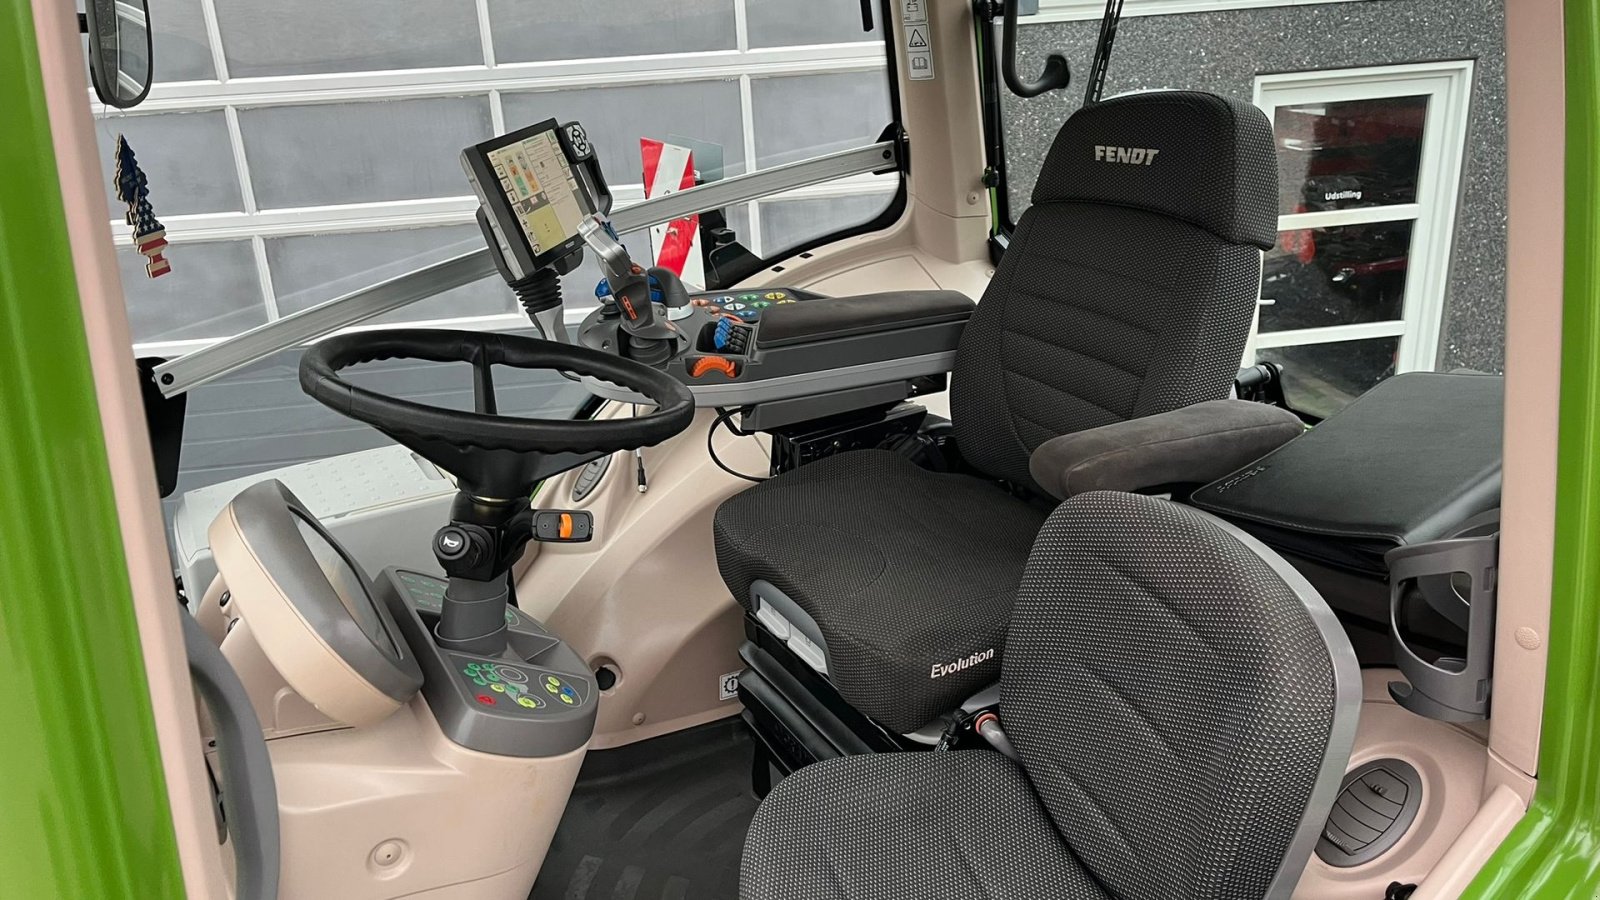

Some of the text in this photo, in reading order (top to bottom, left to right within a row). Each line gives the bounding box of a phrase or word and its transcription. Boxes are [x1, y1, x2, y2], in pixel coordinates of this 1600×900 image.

[1094, 145, 1160, 166] FENDT
[1325, 190, 1362, 200] Udstilling
[930, 648, 994, 679] Evolution
